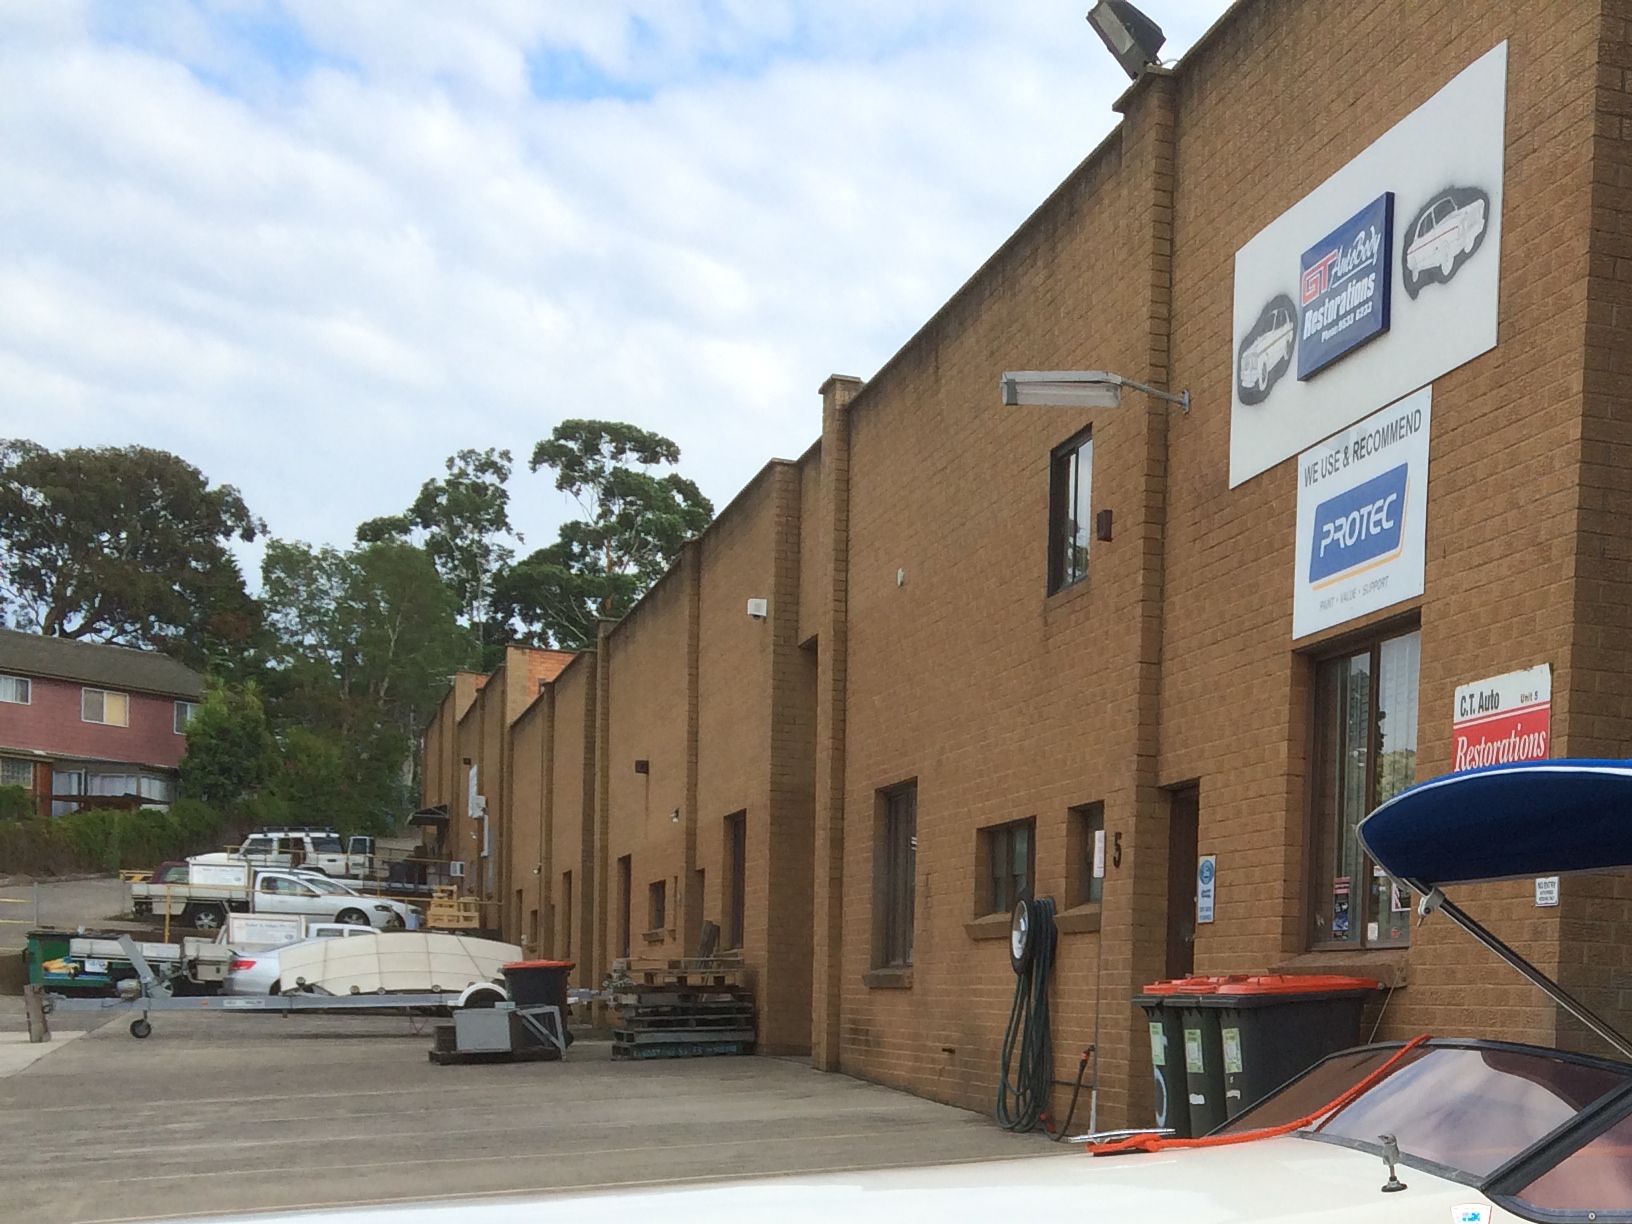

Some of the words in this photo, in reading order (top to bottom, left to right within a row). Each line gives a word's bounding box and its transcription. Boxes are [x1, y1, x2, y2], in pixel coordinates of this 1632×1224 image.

[1302, 249, 1339, 308] GT
[1303, 272, 1376, 340] Restorations
[1304, 462, 1319, 487] WE
[1321, 450, 1341, 479] USE
[1342, 446, 1350, 469] &
[1352, 408, 1422, 463] RECOMMEND
[1319, 492, 1398, 558] PROTEC
[1362, 575, 1389, 597] SUPPORT
[1478, 689, 1500, 713] Auto
[1520, 692, 1533, 704] Unit
[1453, 722, 1547, 772] Restorations
[1113, 831, 1122, 869] 5
